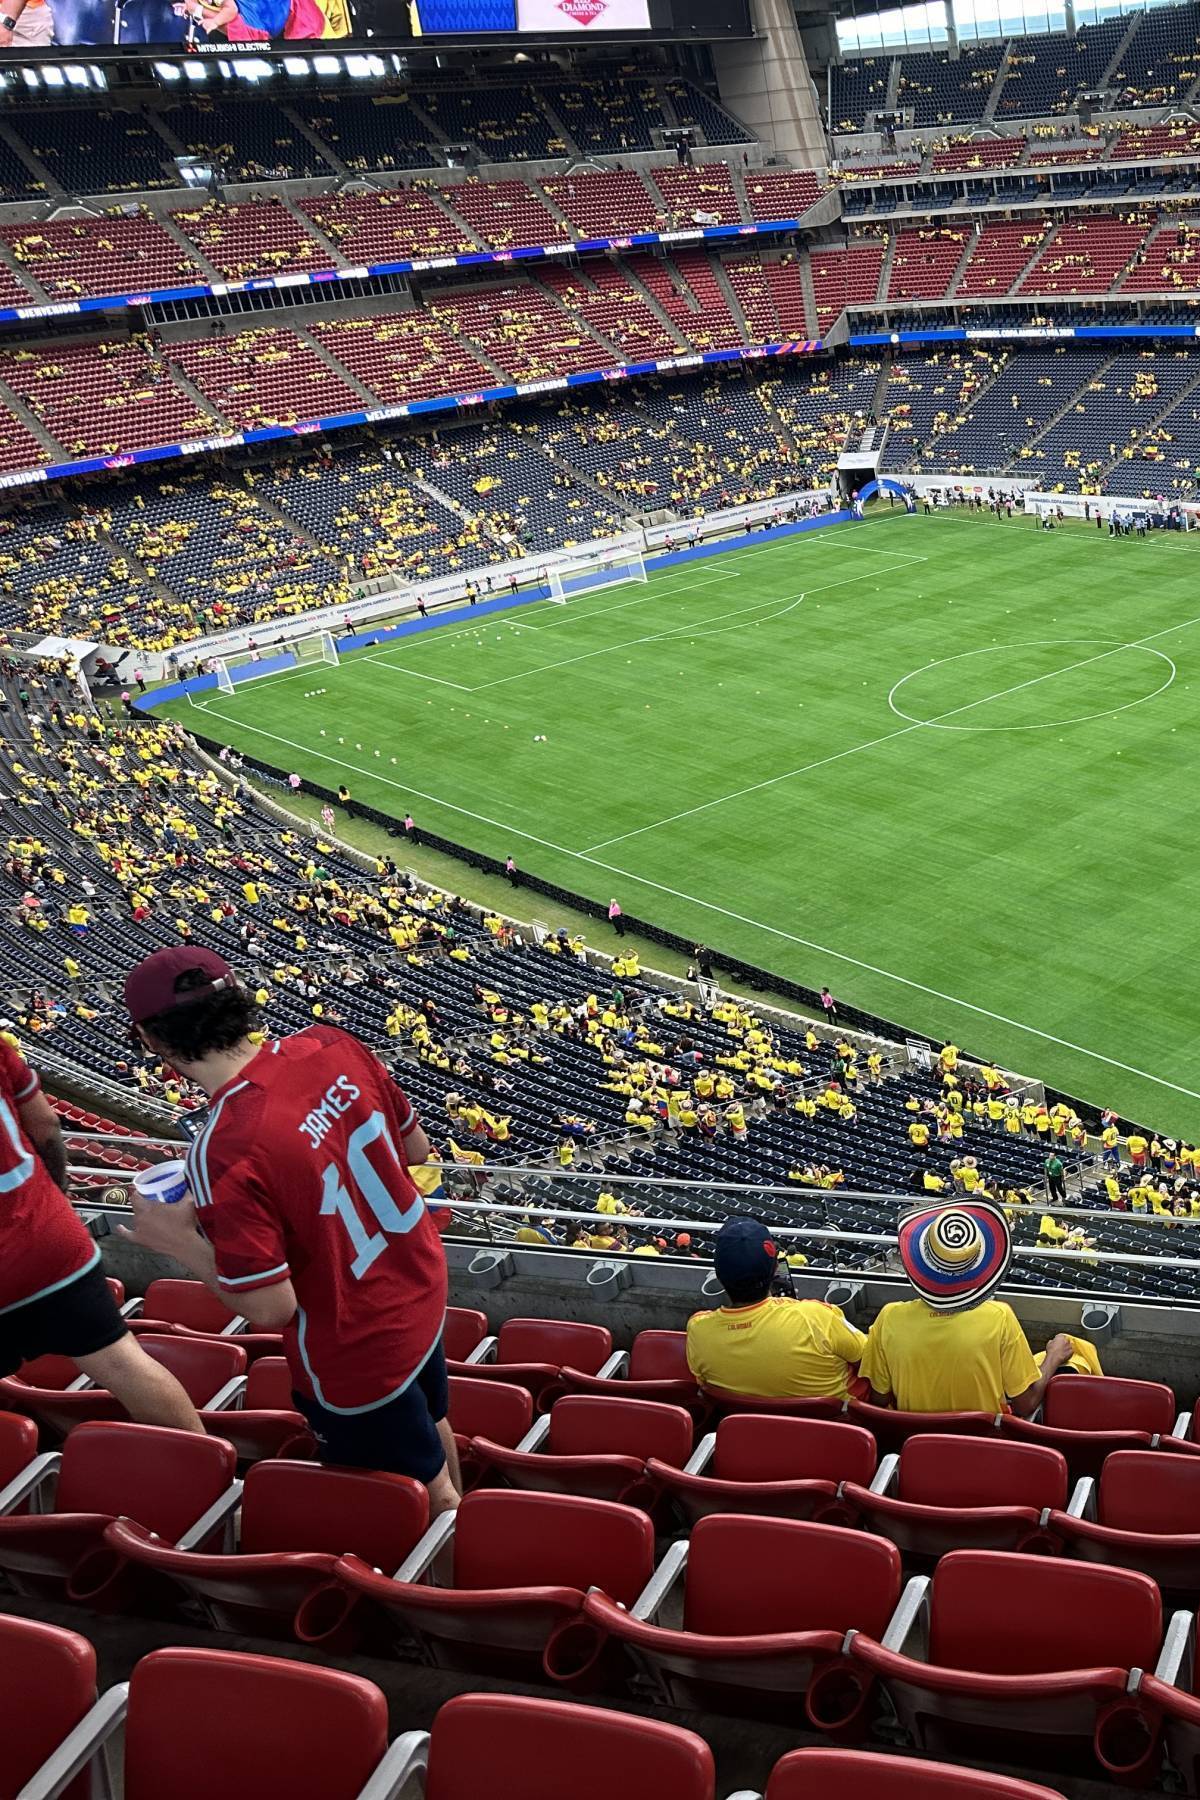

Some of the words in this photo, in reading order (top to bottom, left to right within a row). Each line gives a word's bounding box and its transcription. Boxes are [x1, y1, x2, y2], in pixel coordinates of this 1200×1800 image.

[562, 3, 604, 12] DIAMOND
[197, 42, 238, 53] MITSUBISHI
[238, 41, 272, 52] ELECTRIC
[366, 406, 410, 421] WELCOME
[0, 469, 48, 489] VENIDOS
[298, 1074, 361, 1149] JAMES
[319, 1110, 425, 1280] 10
